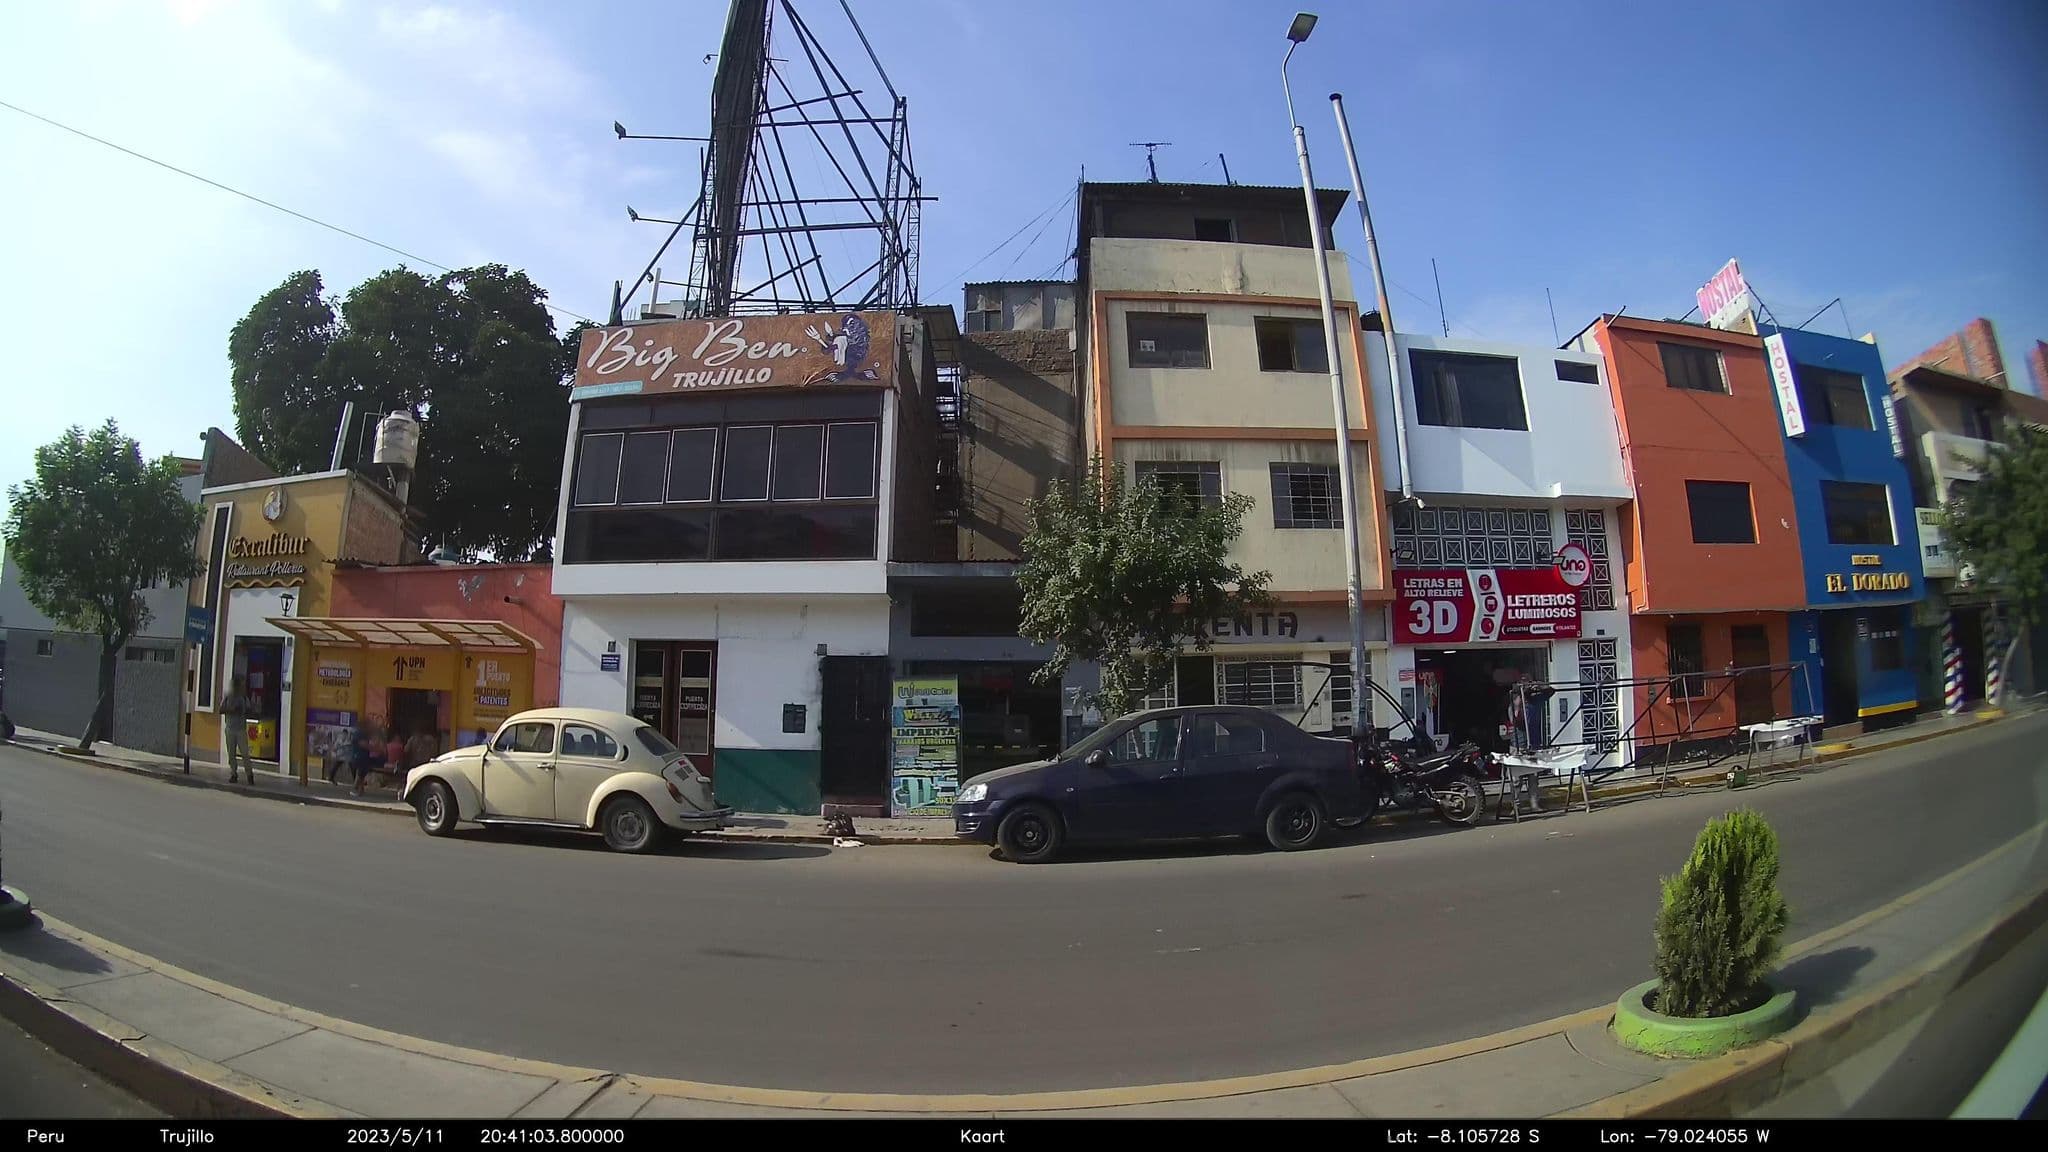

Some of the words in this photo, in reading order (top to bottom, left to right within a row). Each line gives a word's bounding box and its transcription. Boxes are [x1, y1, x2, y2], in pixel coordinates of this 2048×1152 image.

[1697, 261, 1744, 322] HOSTAL
[587, 327, 677, 381] Big
[692, 319, 798, 367] Ben
[672, 366, 772, 389] TRUJILLO
[1771, 342, 1798, 430] HOSTAL
[228, 531, 311, 558] Excalibur
[1403, 578, 1445, 589] LETRAS
[1447, 578, 1463, 588] EN
[1825, 573, 1848, 593] EL
[1851, 572, 1910, 591] DORADO
[1404, 589, 1426, 598] ALTO
[1427, 588, 1464, 597] RELIEVE
[1507, 594, 1576, 607] LETREROS
[1408, 599, 1458, 635] 3D
[1508, 607, 1577, 620] LUMINOSOS
[408, 656, 426, 669] UPN
[480, 696, 509, 706] PATENTES
[896, 728, 955, 737] IMPRENTA
